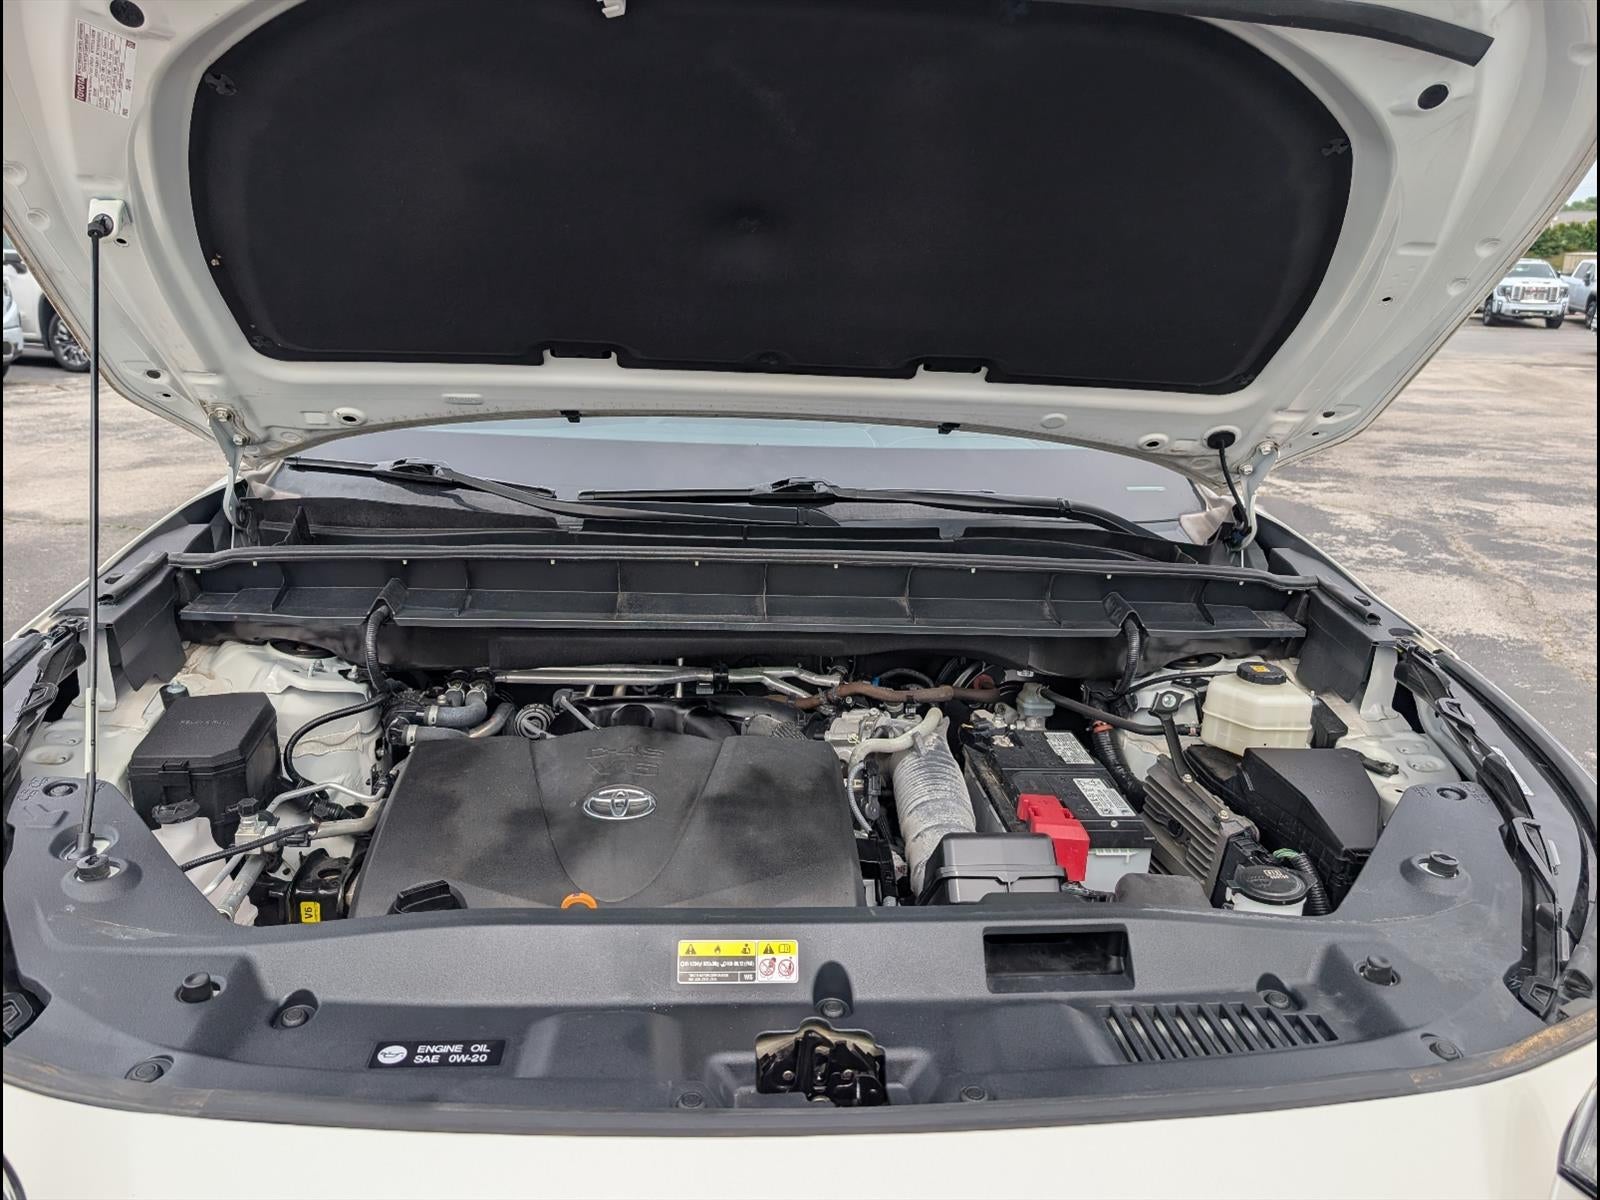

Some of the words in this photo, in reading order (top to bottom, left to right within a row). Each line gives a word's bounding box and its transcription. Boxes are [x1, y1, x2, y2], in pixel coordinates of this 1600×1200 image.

[75, 76, 87, 101] TOYOTA
[304, 906, 313, 919] V6
[417, 1044, 464, 1053] ENGINE
[470, 1044, 491, 1053] OIL
[413, 1055, 441, 1064] SAE
[448, 1054, 488, 1063] 0W-20
